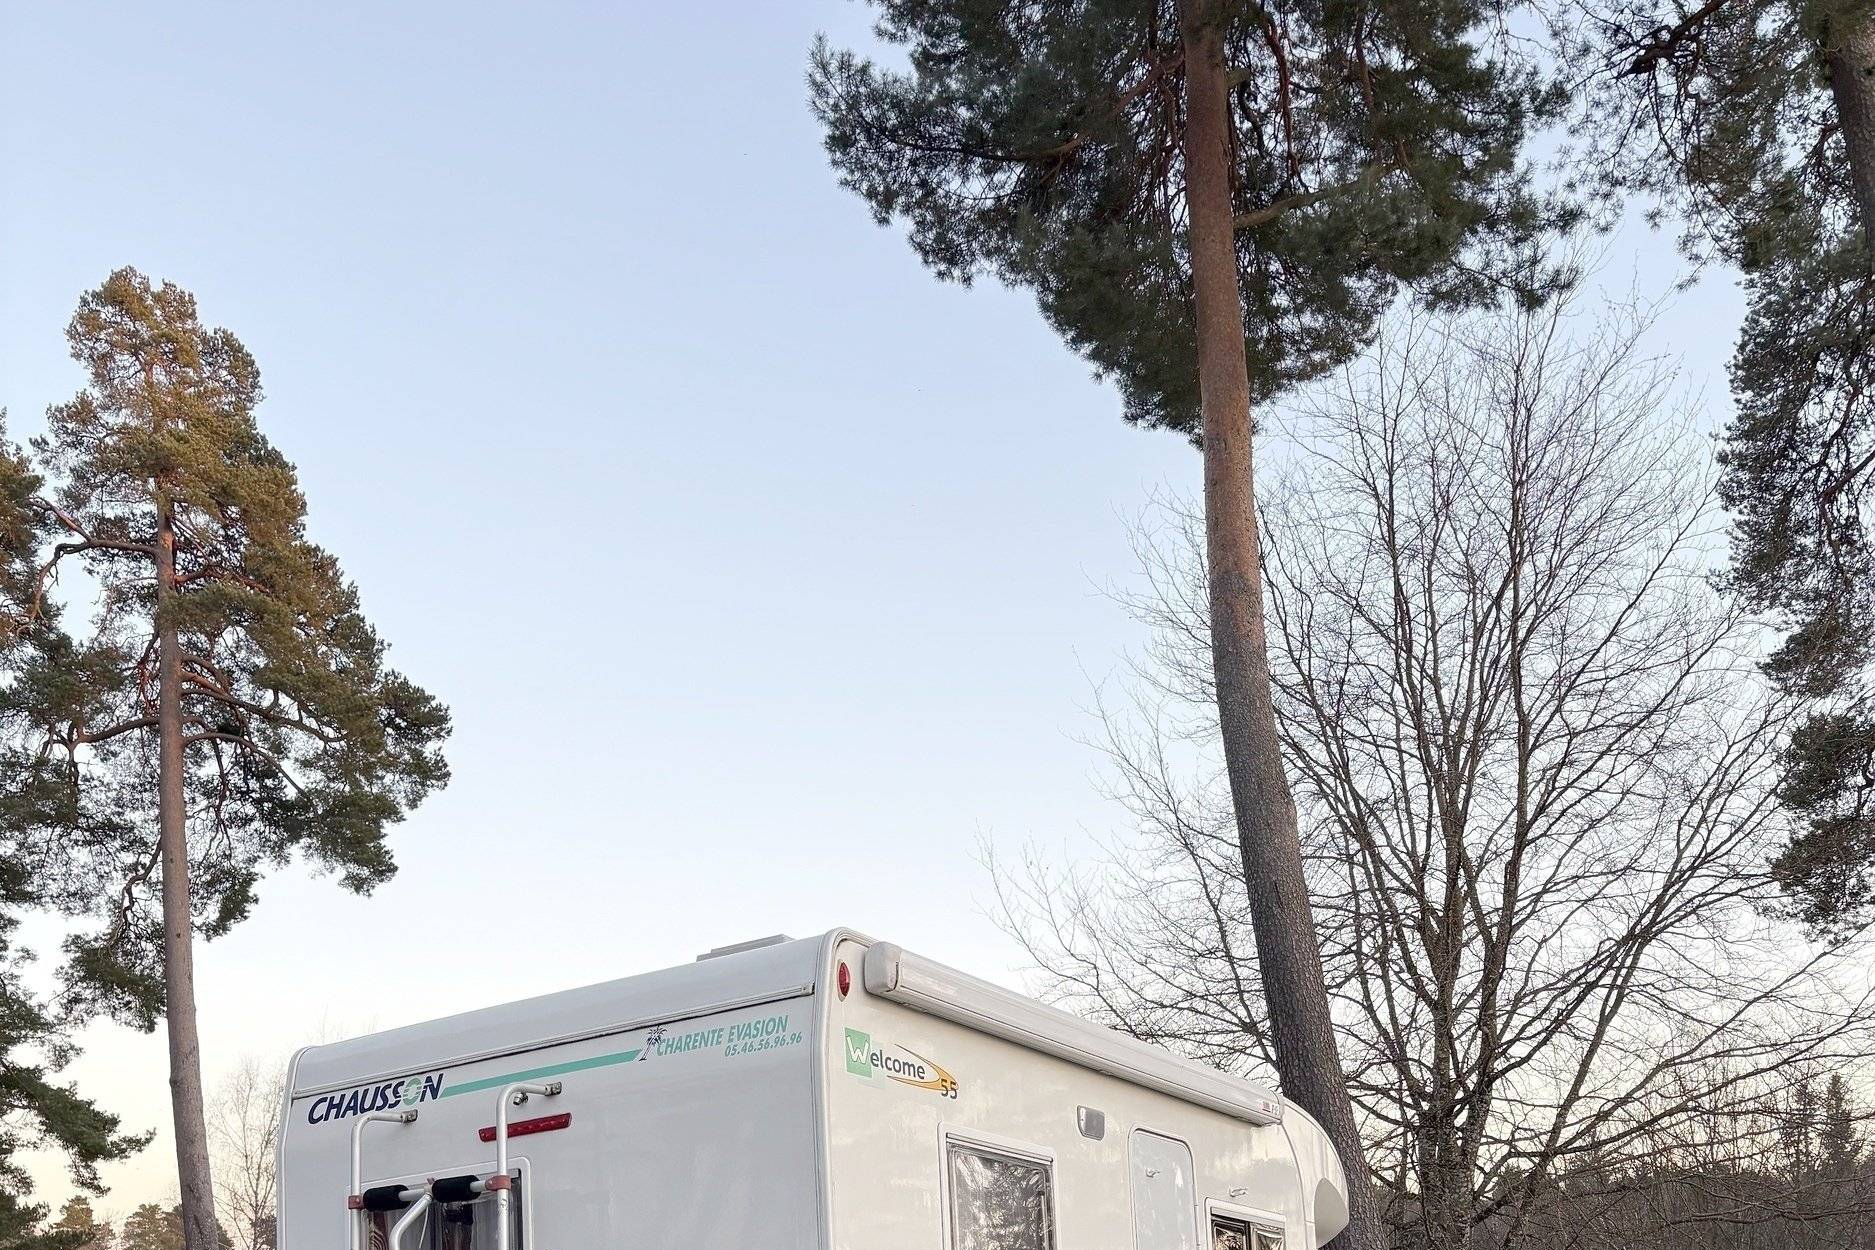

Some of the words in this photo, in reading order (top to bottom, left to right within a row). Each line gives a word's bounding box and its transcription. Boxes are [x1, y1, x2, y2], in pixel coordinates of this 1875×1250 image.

[656, 1027, 725, 1057] CHARENTE
[727, 1015, 789, 1043] EVASION
[724, 1032, 803, 1057] 05.46.56.96.96
[845, 1035, 926, 1080] Welcome
[308, 1073, 444, 1124] CHAUSSON
[940, 1078, 959, 1100] 55
